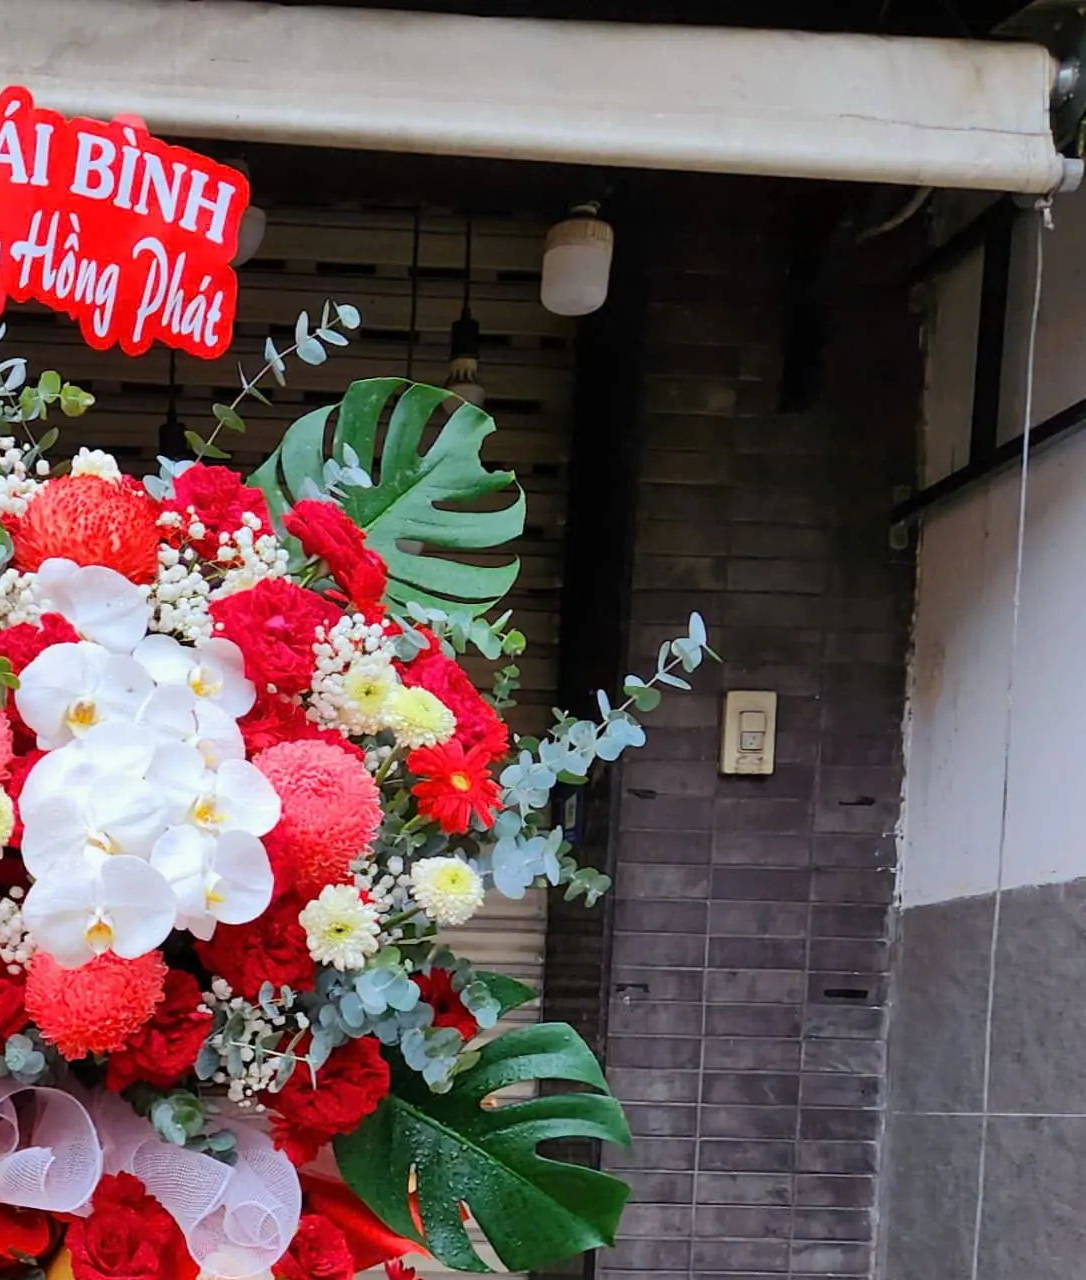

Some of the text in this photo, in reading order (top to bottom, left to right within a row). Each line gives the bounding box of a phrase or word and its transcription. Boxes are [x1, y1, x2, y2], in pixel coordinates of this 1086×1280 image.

[70, 126, 236, 245] BÌNH
[10, 209, 120, 338] Hồng
[132, 236, 224, 347] Phát
